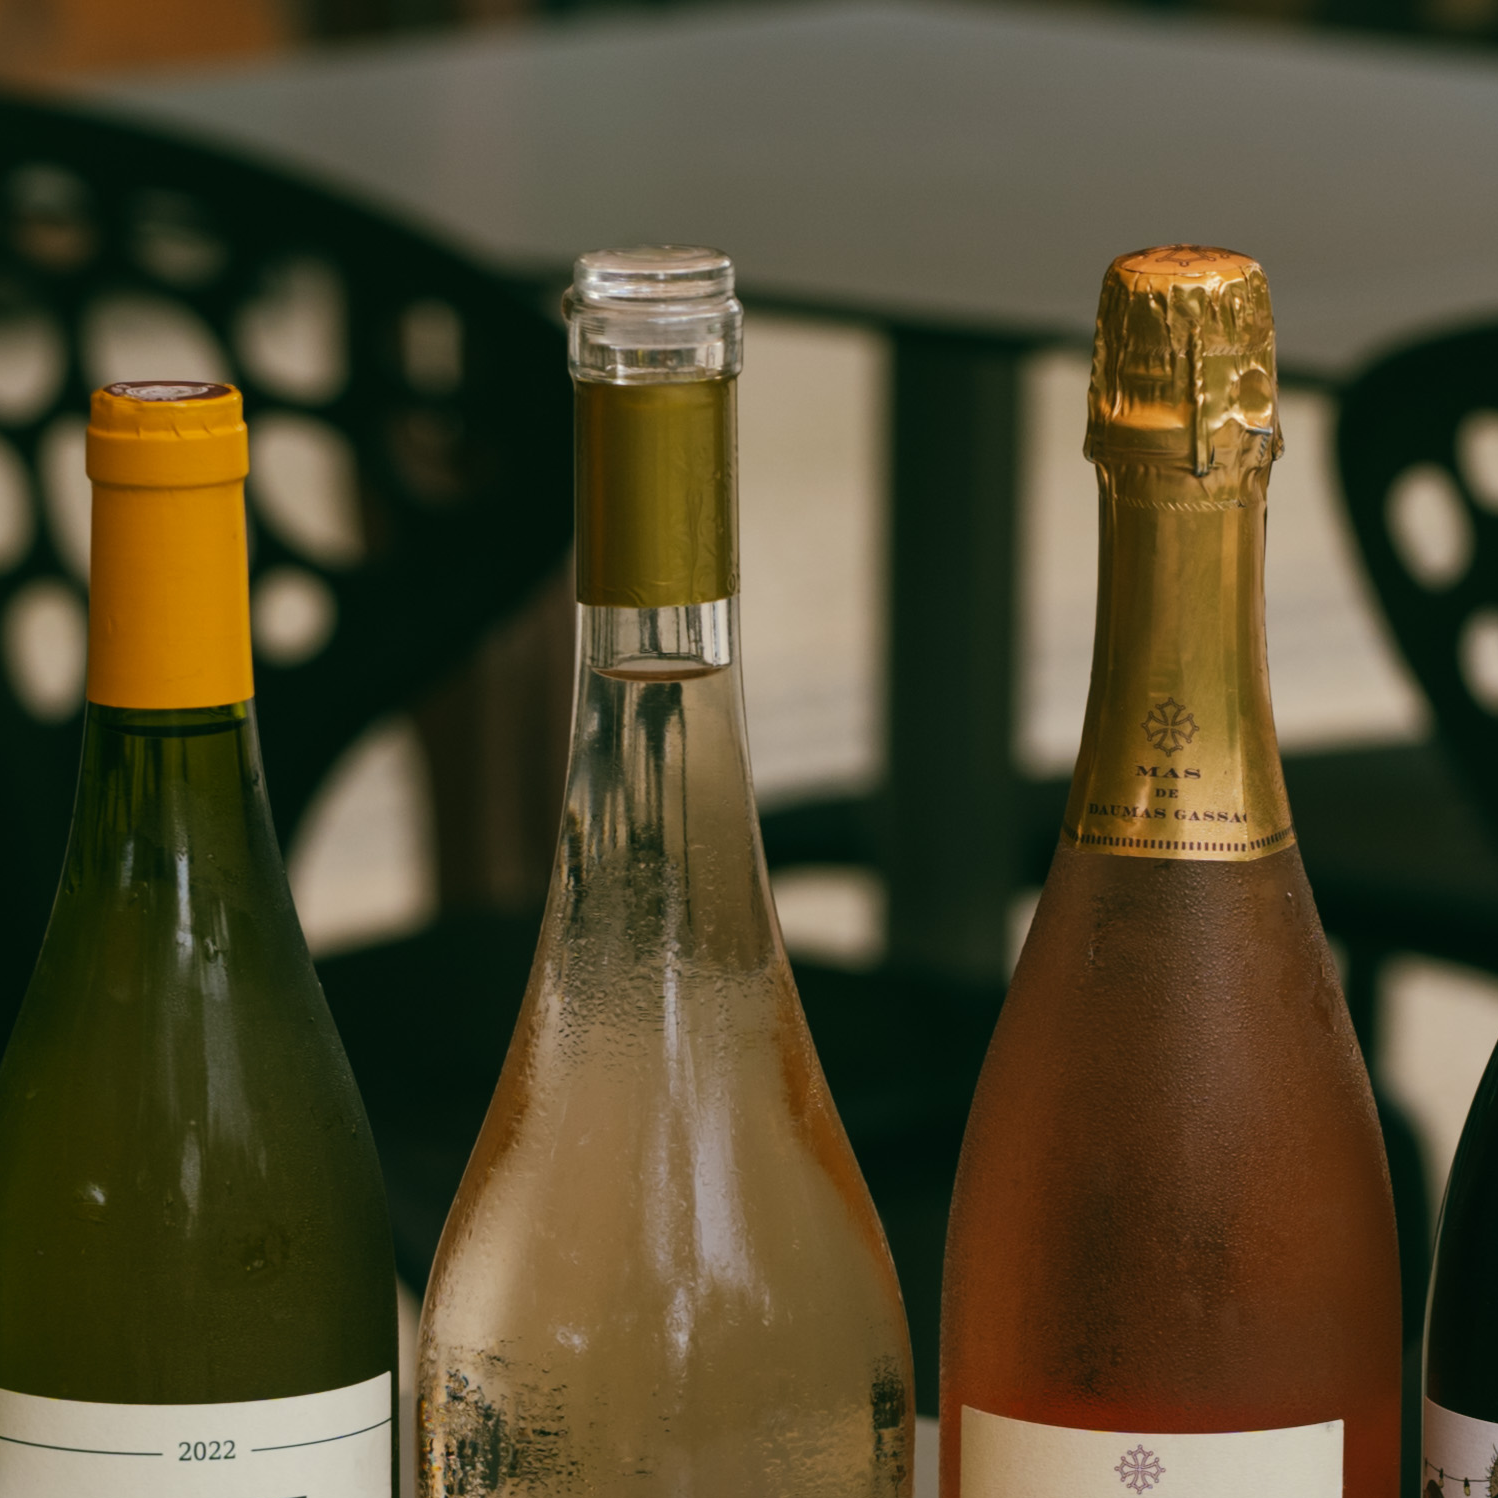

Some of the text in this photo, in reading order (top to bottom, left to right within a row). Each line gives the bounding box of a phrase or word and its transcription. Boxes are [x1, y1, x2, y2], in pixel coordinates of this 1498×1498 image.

[1136, 765, 1201, 779] MAS
[1155, 788, 1179, 799] DE
[1088, 802, 1166, 819] DAUMAS
[178, 1440, 237, 1462] 2022
